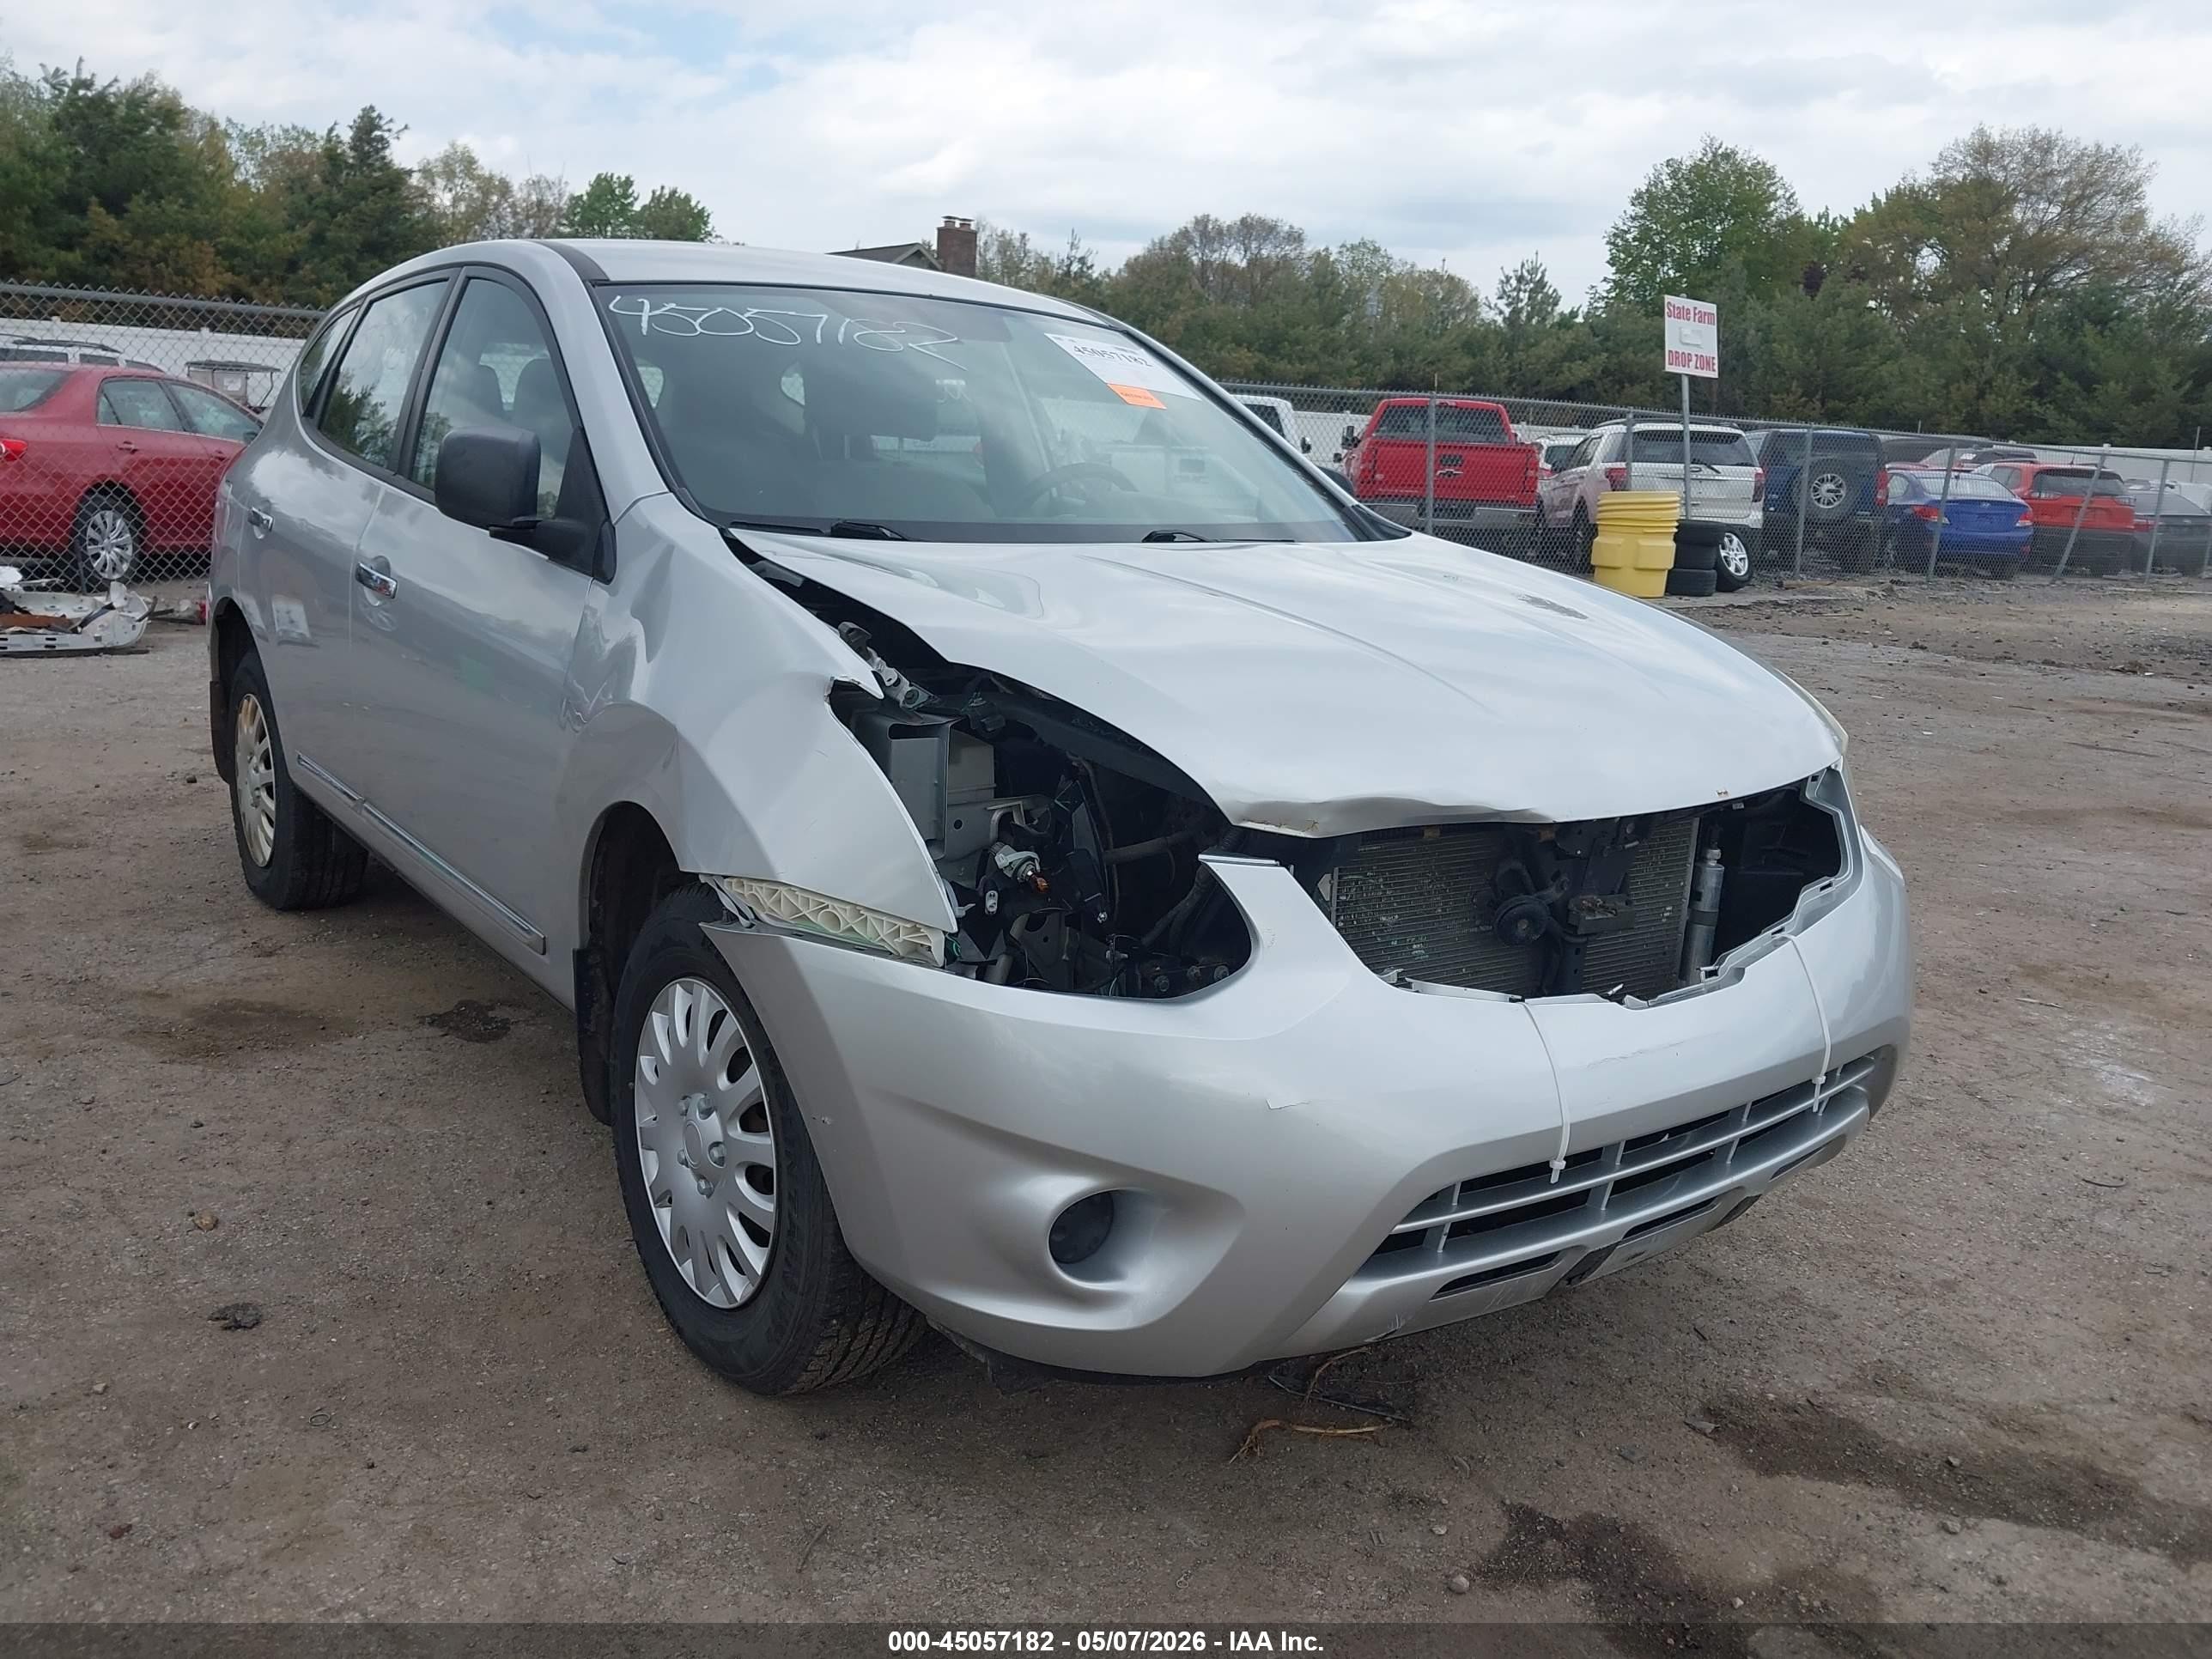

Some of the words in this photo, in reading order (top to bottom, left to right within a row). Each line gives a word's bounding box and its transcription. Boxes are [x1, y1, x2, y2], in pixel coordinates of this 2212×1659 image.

[1666, 301, 1691, 321] State
[1692, 307, 1716, 325] Farm
[608, 295, 969, 372] 45057182
[1668, 349, 1692, 368] DROP
[1694, 353, 1716, 372] ZONE
